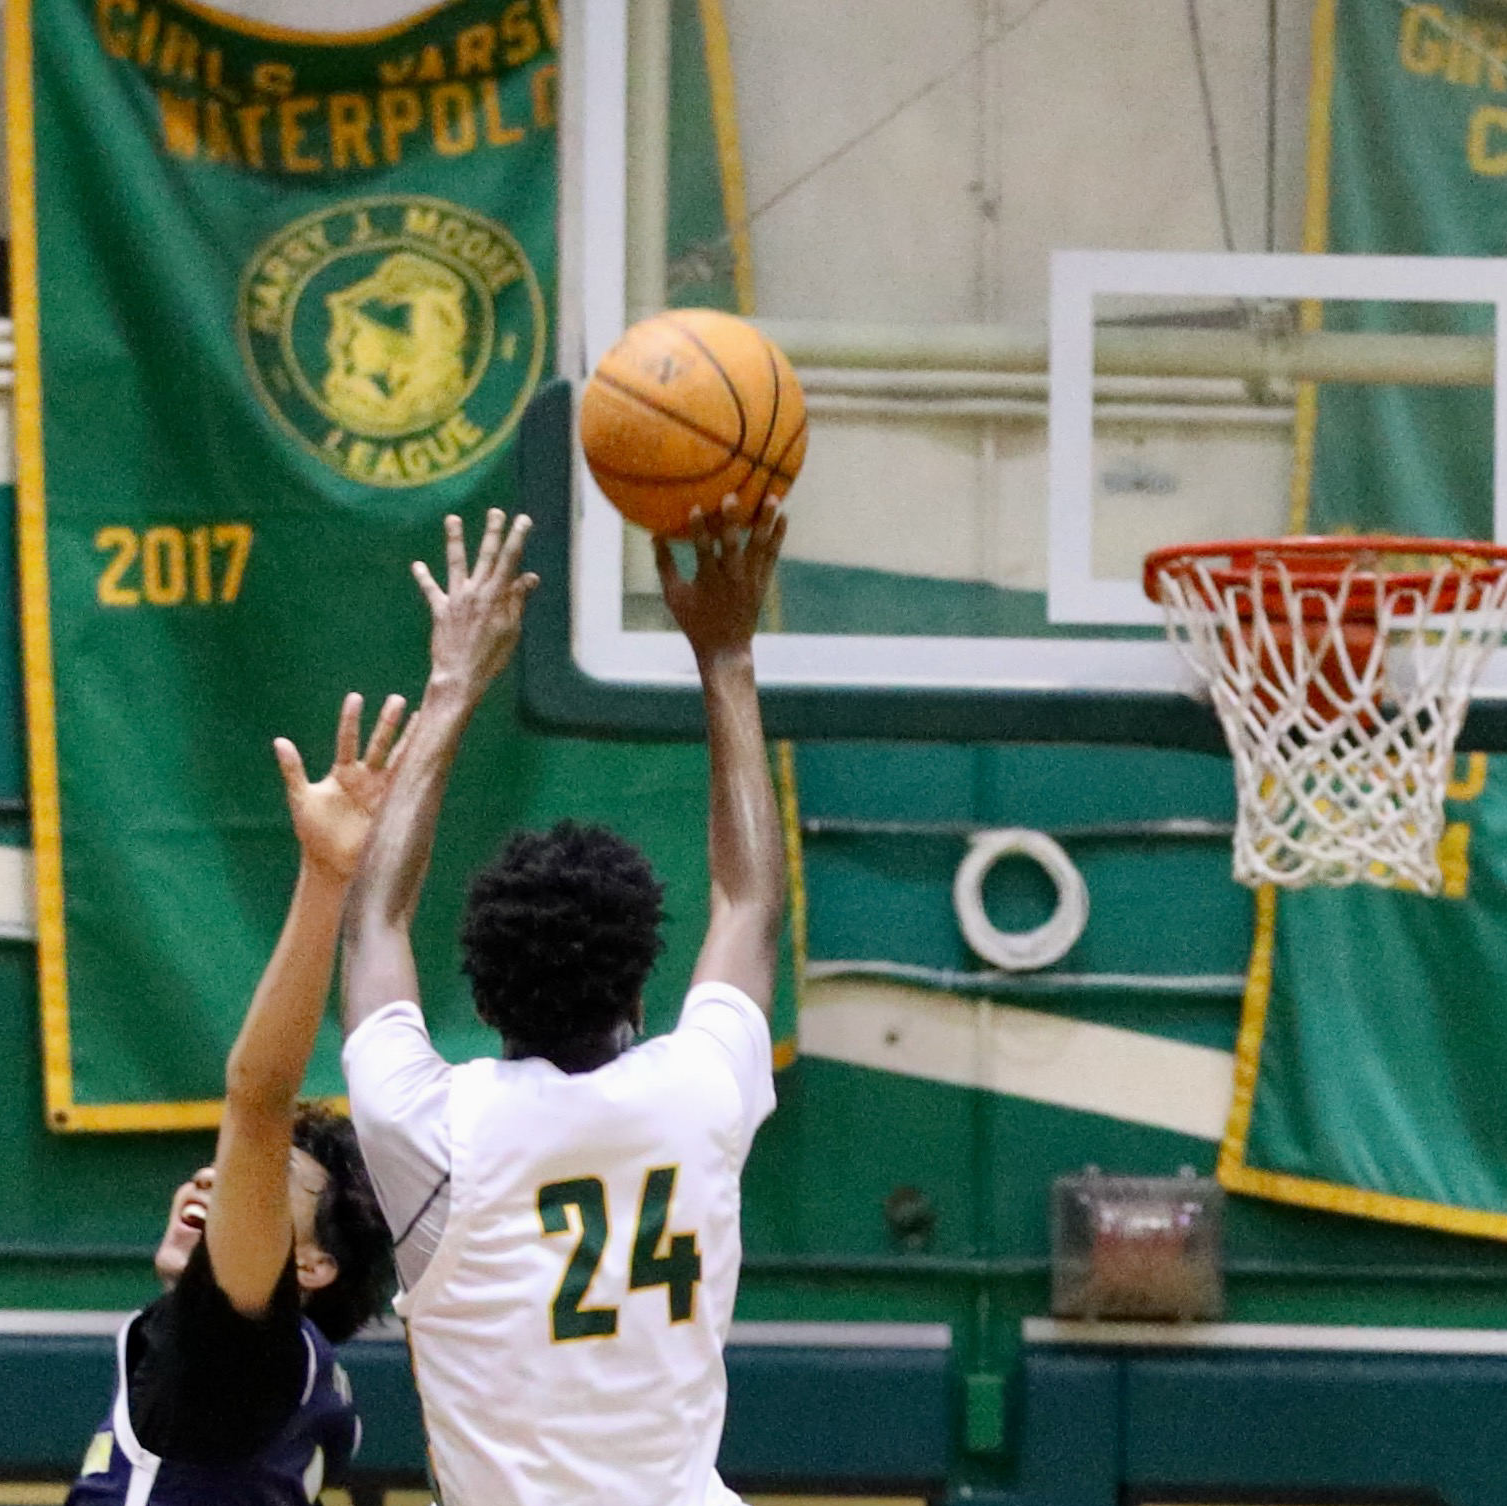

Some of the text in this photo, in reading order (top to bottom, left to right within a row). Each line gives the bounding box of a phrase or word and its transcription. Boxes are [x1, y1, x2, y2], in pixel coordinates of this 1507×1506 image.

[321, 410, 485, 482] LEAGUE
[97, 525, 252, 606] 2017
[536, 1162, 702, 1345] 24
